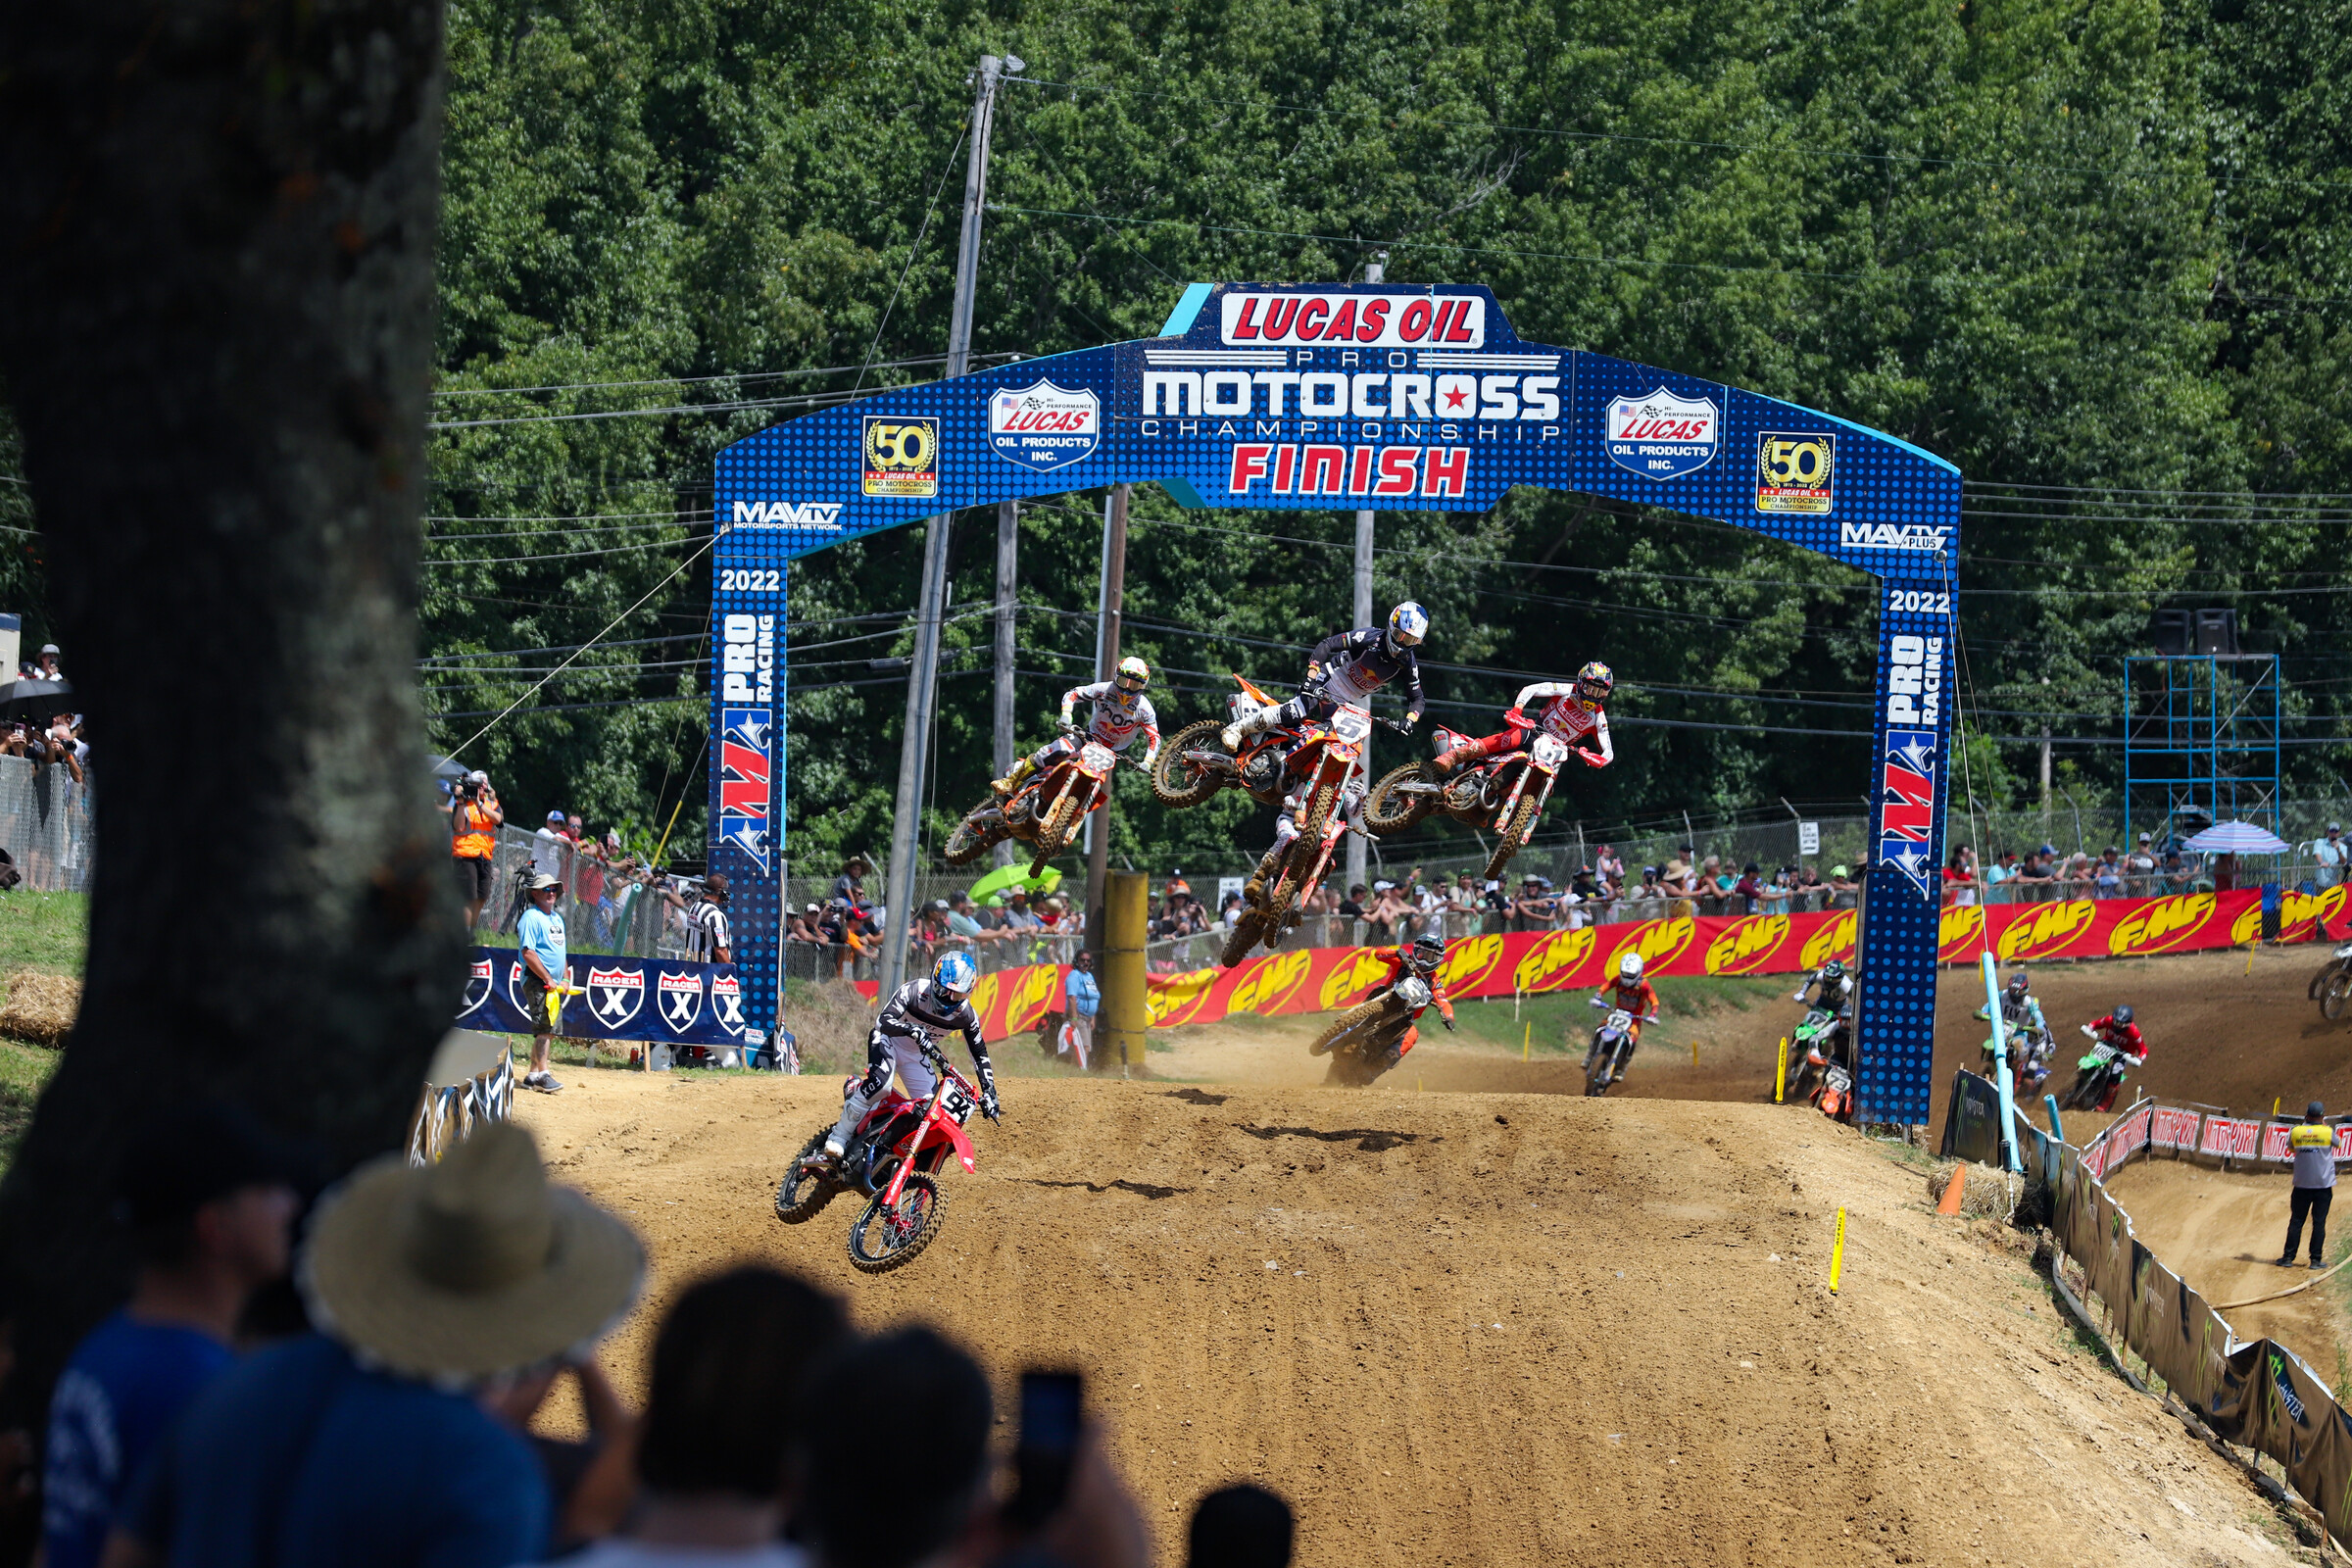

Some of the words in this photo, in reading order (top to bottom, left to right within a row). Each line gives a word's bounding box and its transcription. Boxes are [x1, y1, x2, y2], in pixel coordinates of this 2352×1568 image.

[1232, 298, 1392, 343] LUCAS
[1398, 299, 1473, 343] OIL
[1297, 352, 1408, 368] PRO
[1142, 370, 1561, 420] MOTOCROSS
[1002, 411, 1091, 431] LUCAS
[1141, 419, 1560, 441] CHAMPIONSHIP
[1619, 418, 1709, 440] LUCAS
[874, 424, 930, 467] 50
[996, 436, 1018, 448] OIL
[1021, 437, 1092, 448] PRODUCTS
[1612, 444, 1636, 456] OIL
[1639, 445, 1709, 457] PRODUCTS
[1031, 451, 1058, 462] INC.
[1228, 442, 1471, 498] FINISH
[1647, 459, 1675, 470] INC.
[1768, 440, 1826, 483] 50
[1779, 496, 1828, 505] MOTOCROSS
[733, 521, 800, 530] MOTORSPORTS
[800, 522, 843, 531] NETWORK
[1908, 537, 1936, 549] PLUS
[720, 569, 780, 592] 2022
[1888, 590, 1950, 614] 2022
[722, 613, 758, 703] PRO
[756, 614, 774, 703] RACING
[1887, 635, 1926, 724] PRO
[1922, 637, 1943, 725] RACING
[1336, 716, 1366, 739] 5
[2000, 900, 2093, 960] FMF
[2112, 892, 2216, 956] FMF
[1708, 913, 1788, 975] FMF
[1519, 926, 1594, 992] FMF
[593, 975, 640, 986] RACER
[662, 980, 700, 991] RACER
[1231, 949, 1310, 1012] FMF
[599, 988, 628, 1016] X
[668, 992, 693, 1020] X
[722, 995, 745, 1023] X
[1007, 963, 1057, 1036] FMF
[862, 1076, 882, 1097] FOX
[941, 1091, 971, 1124] 94
[890, 1164, 907, 1197] DUNLOP
